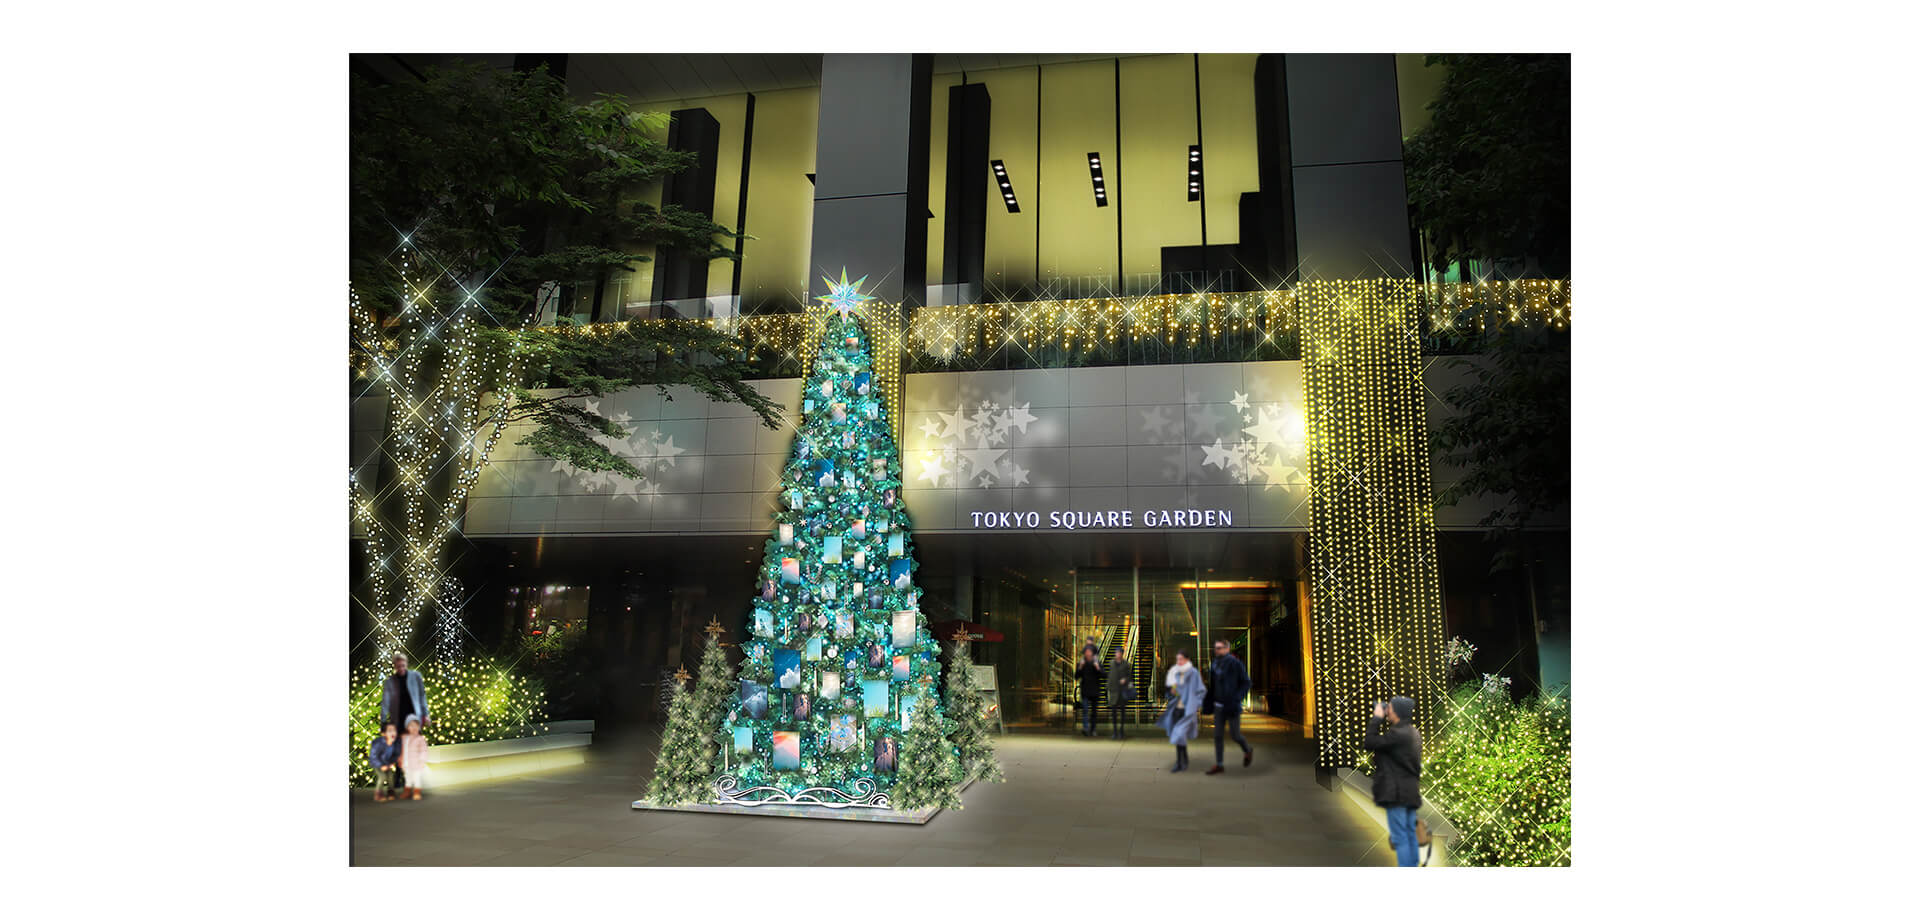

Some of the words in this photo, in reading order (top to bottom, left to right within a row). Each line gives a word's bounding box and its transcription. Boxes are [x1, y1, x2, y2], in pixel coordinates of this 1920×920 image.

[970, 511, 1040, 528] TOKYO
[1049, 510, 1133, 530] SQUARE
[1143, 508, 1232, 527] GARDEN
